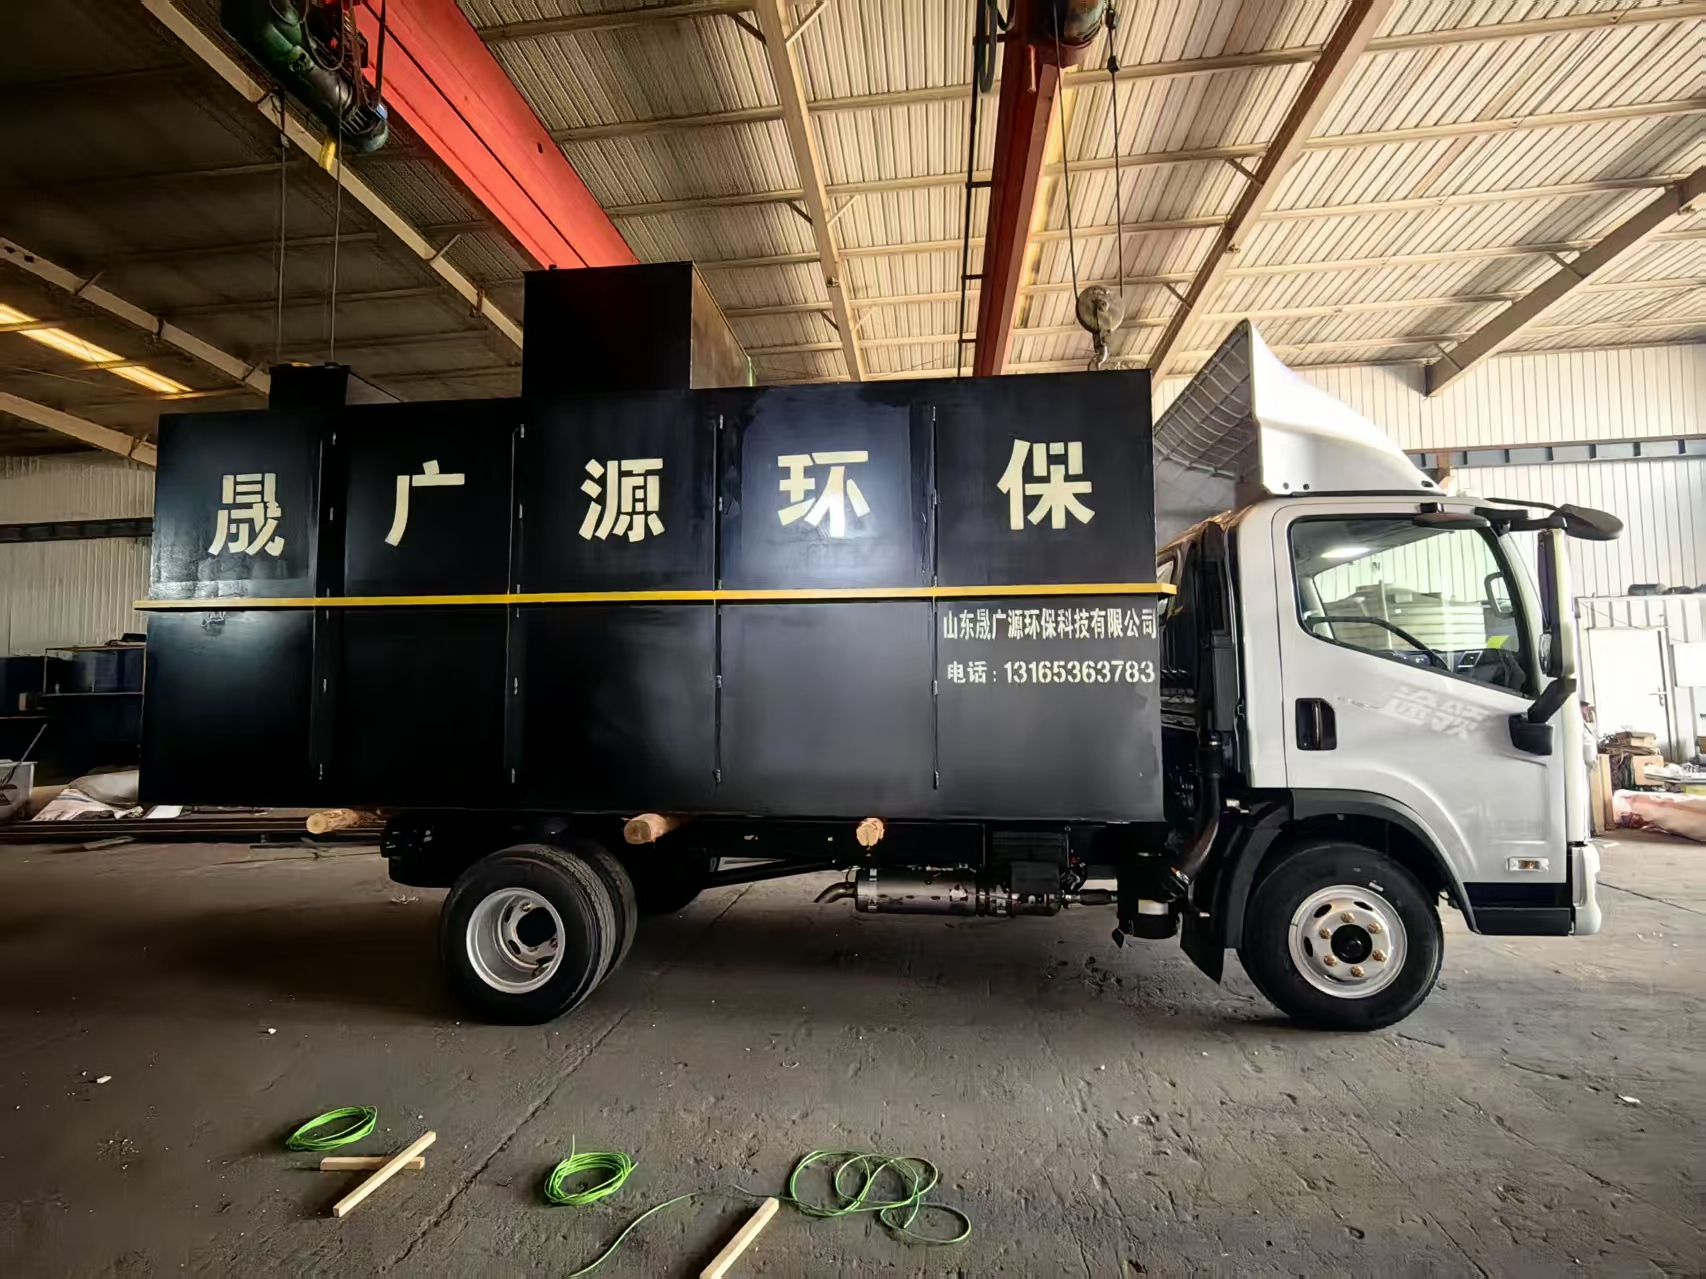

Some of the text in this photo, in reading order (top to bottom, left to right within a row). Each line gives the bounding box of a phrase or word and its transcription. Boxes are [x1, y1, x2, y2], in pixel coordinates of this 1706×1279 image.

[207, 439, 1096, 558] 晟广源环保
[943, 607, 1157, 641] 山东晟广源环保科技有限公司
